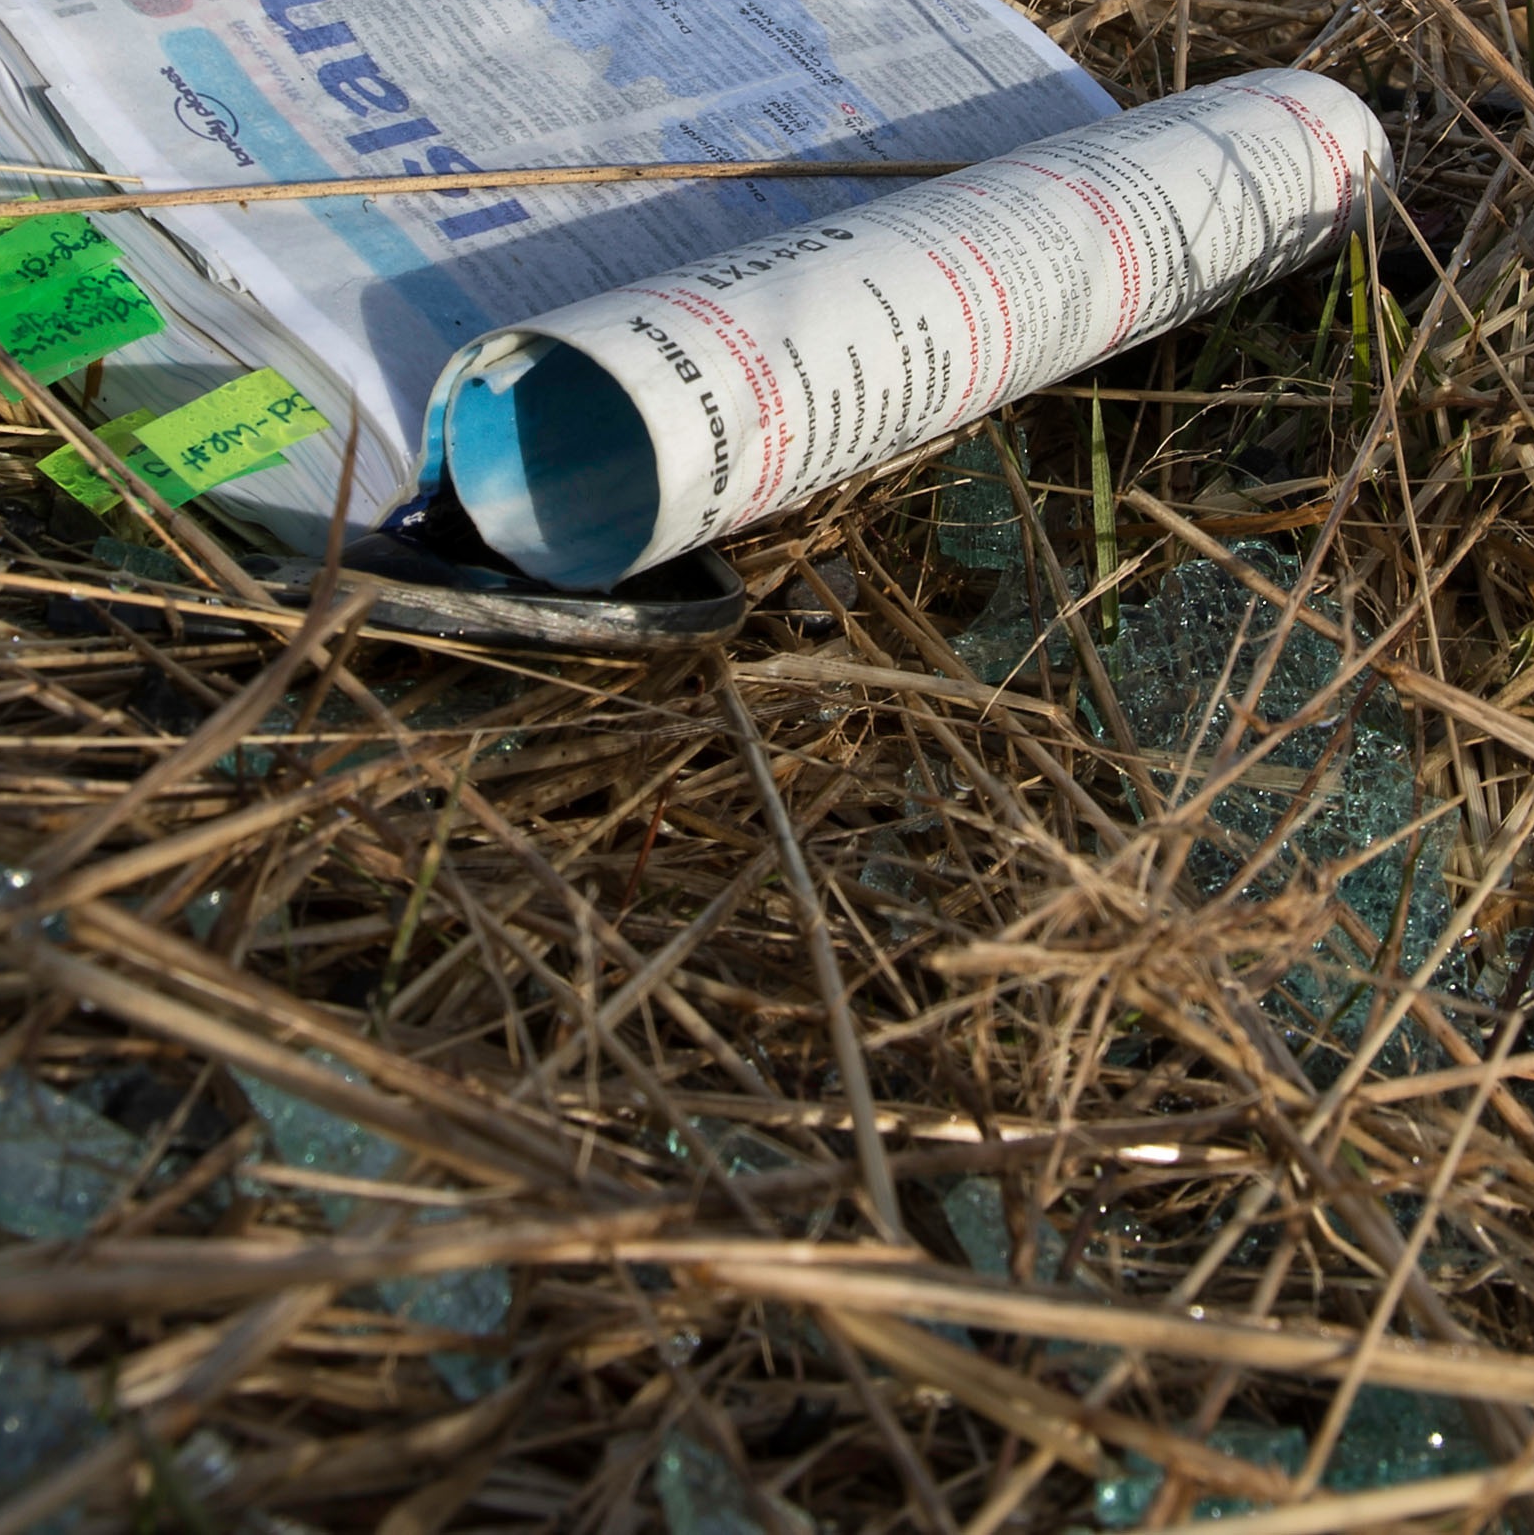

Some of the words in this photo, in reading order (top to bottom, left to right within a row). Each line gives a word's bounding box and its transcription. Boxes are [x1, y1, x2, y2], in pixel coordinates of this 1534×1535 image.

[666, 13, 692, 34] Das
[750, 18, 828, 84] Südwestisland
[775, 27, 822, 66] Goldene
[160, 66, 216, 119] planet
[200, 119, 255, 167] lonely
[1121, 157, 1153, 181] man
[1225, 130, 1277, 195] verfügbar
[1249, 133, 1293, 203] verfügbar
[989, 195, 1050, 251] Rubriken
[1065, 181, 1110, 226] bieten
[1138, 191, 1161, 221] und
[1154, 184, 1188, 247] bezahlt
[1233, 172, 1257, 263] chtraucher
[1332, 166, 1343, 225] Karten
[1038, 203, 1084, 262] Autoren
[1121, 195, 1158, 287] empfehlen
[940, 247, 982, 306] werden
[998, 264, 1021, 307] nach
[1026, 259, 1044, 292] den
[1049, 255, 1065, 284] der
[1061, 255, 1080, 300] Preis
[1080, 268, 1092, 298] der
[1108, 229, 1131, 310] Symbole
[1155, 225, 1174, 320] Nachhaltig
[1179, 250, 1190, 289] Hier
[671, 300, 714, 326] sind
[862, 278, 904, 342] Touren
[917, 315, 929, 332] &
[926, 250, 979, 400] Beschreibungen
[1018, 289, 1038, 375] besuchen
[1039, 297, 1050, 341] nach
[1070, 304, 1081, 342] dem
[1141, 291, 1156, 323] Das
[628, 316, 702, 384] Blick
[736, 328, 757, 350] zu
[975, 311, 992, 394] Favoriten
[715, 328, 770, 430] Symbolen
[755, 353, 784, 416] leicht
[846, 345, 866, 454] Aktivitäten
[895, 345, 913, 432] Geführte
[917, 336, 936, 421] Festivals
[933, 350, 950, 414] Events
[782, 337, 816, 480] Sehenswertes
[821, 389, 841, 468] Strände
[870, 388, 890, 444] Kurse
[699, 391, 728, 496] einen
[752, 435, 772, 502] diesen
